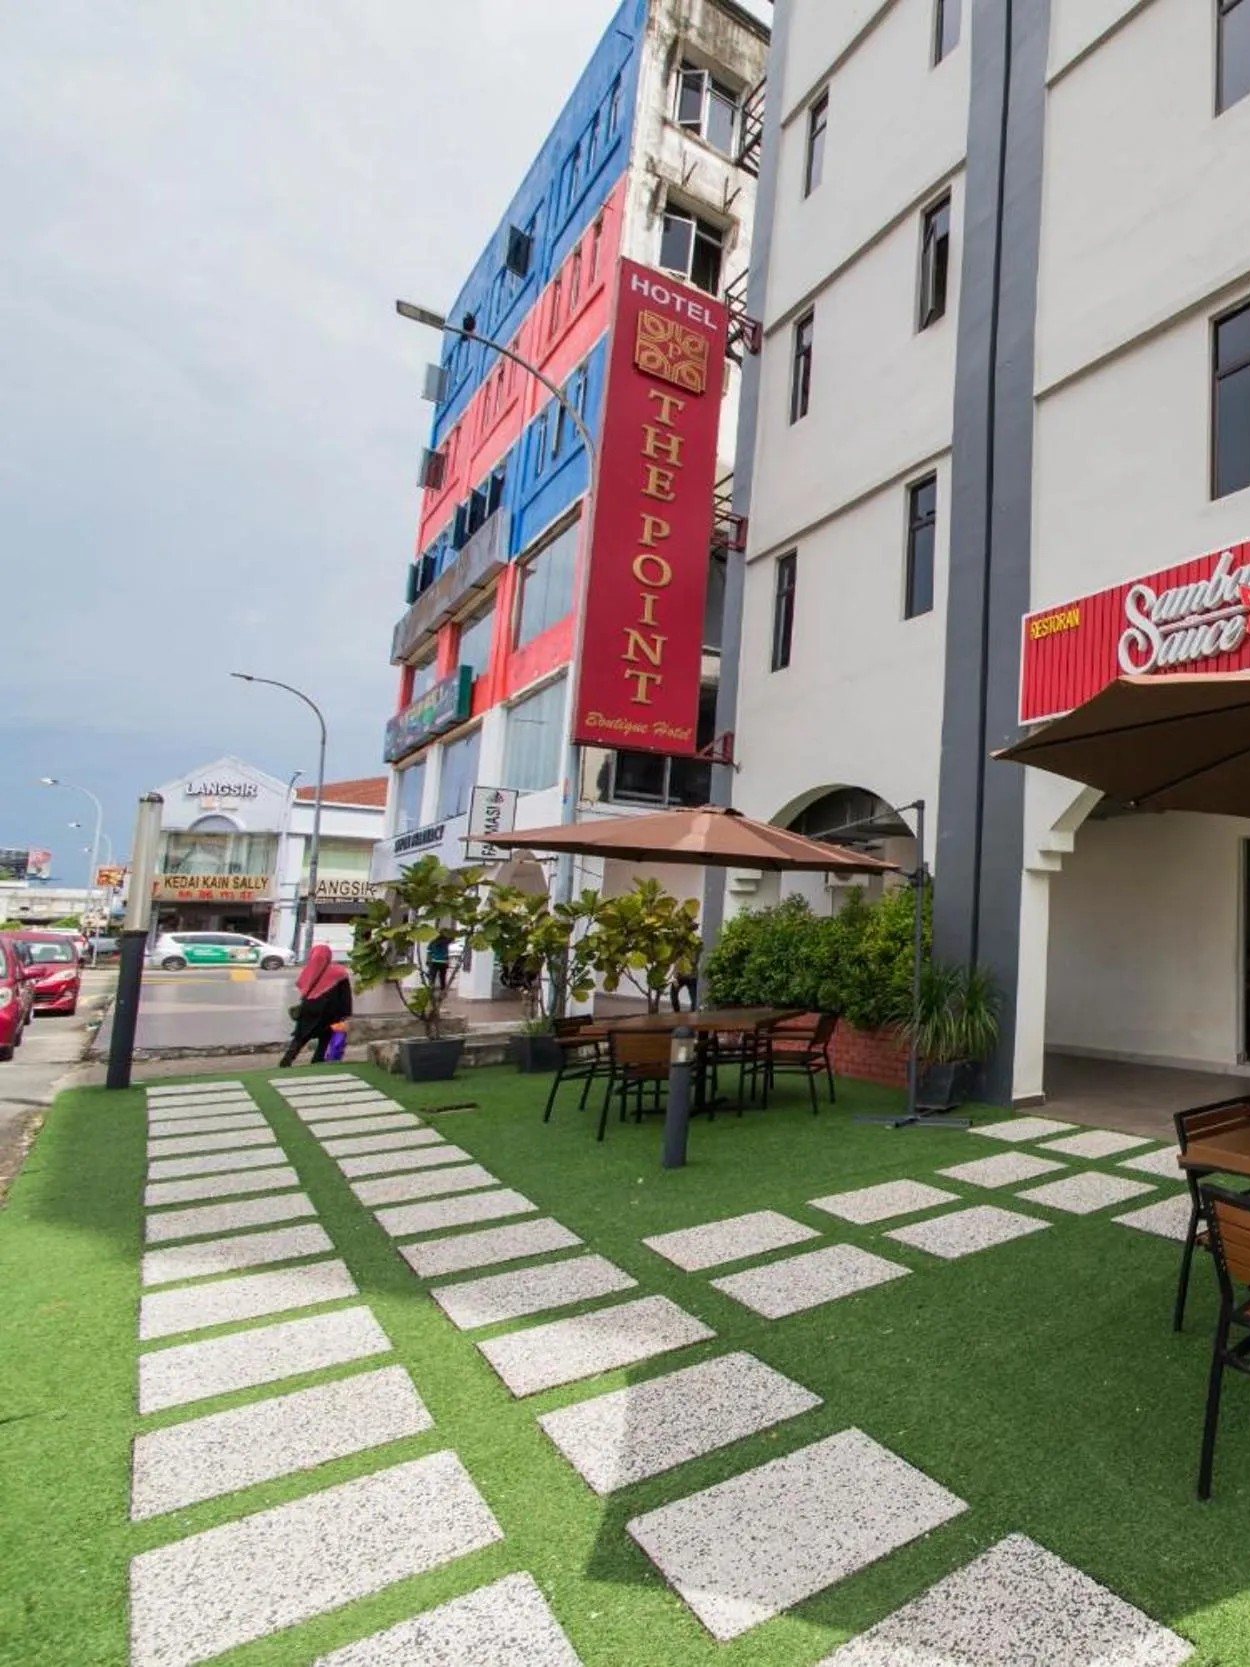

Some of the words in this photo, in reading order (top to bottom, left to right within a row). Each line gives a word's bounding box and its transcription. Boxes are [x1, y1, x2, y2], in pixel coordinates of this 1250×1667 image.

[631, 273, 718, 330] HOTEL
[641, 389, 685, 501] THE
[621, 513, 673, 705] POINT
[1030, 606, 1081, 640] RESTORAN
[186, 782, 258, 797] LANGSIR
[164, 876, 199, 889] KEDAI
[203, 876, 229, 889] KAIN
[232, 876, 270, 889] SALLY
